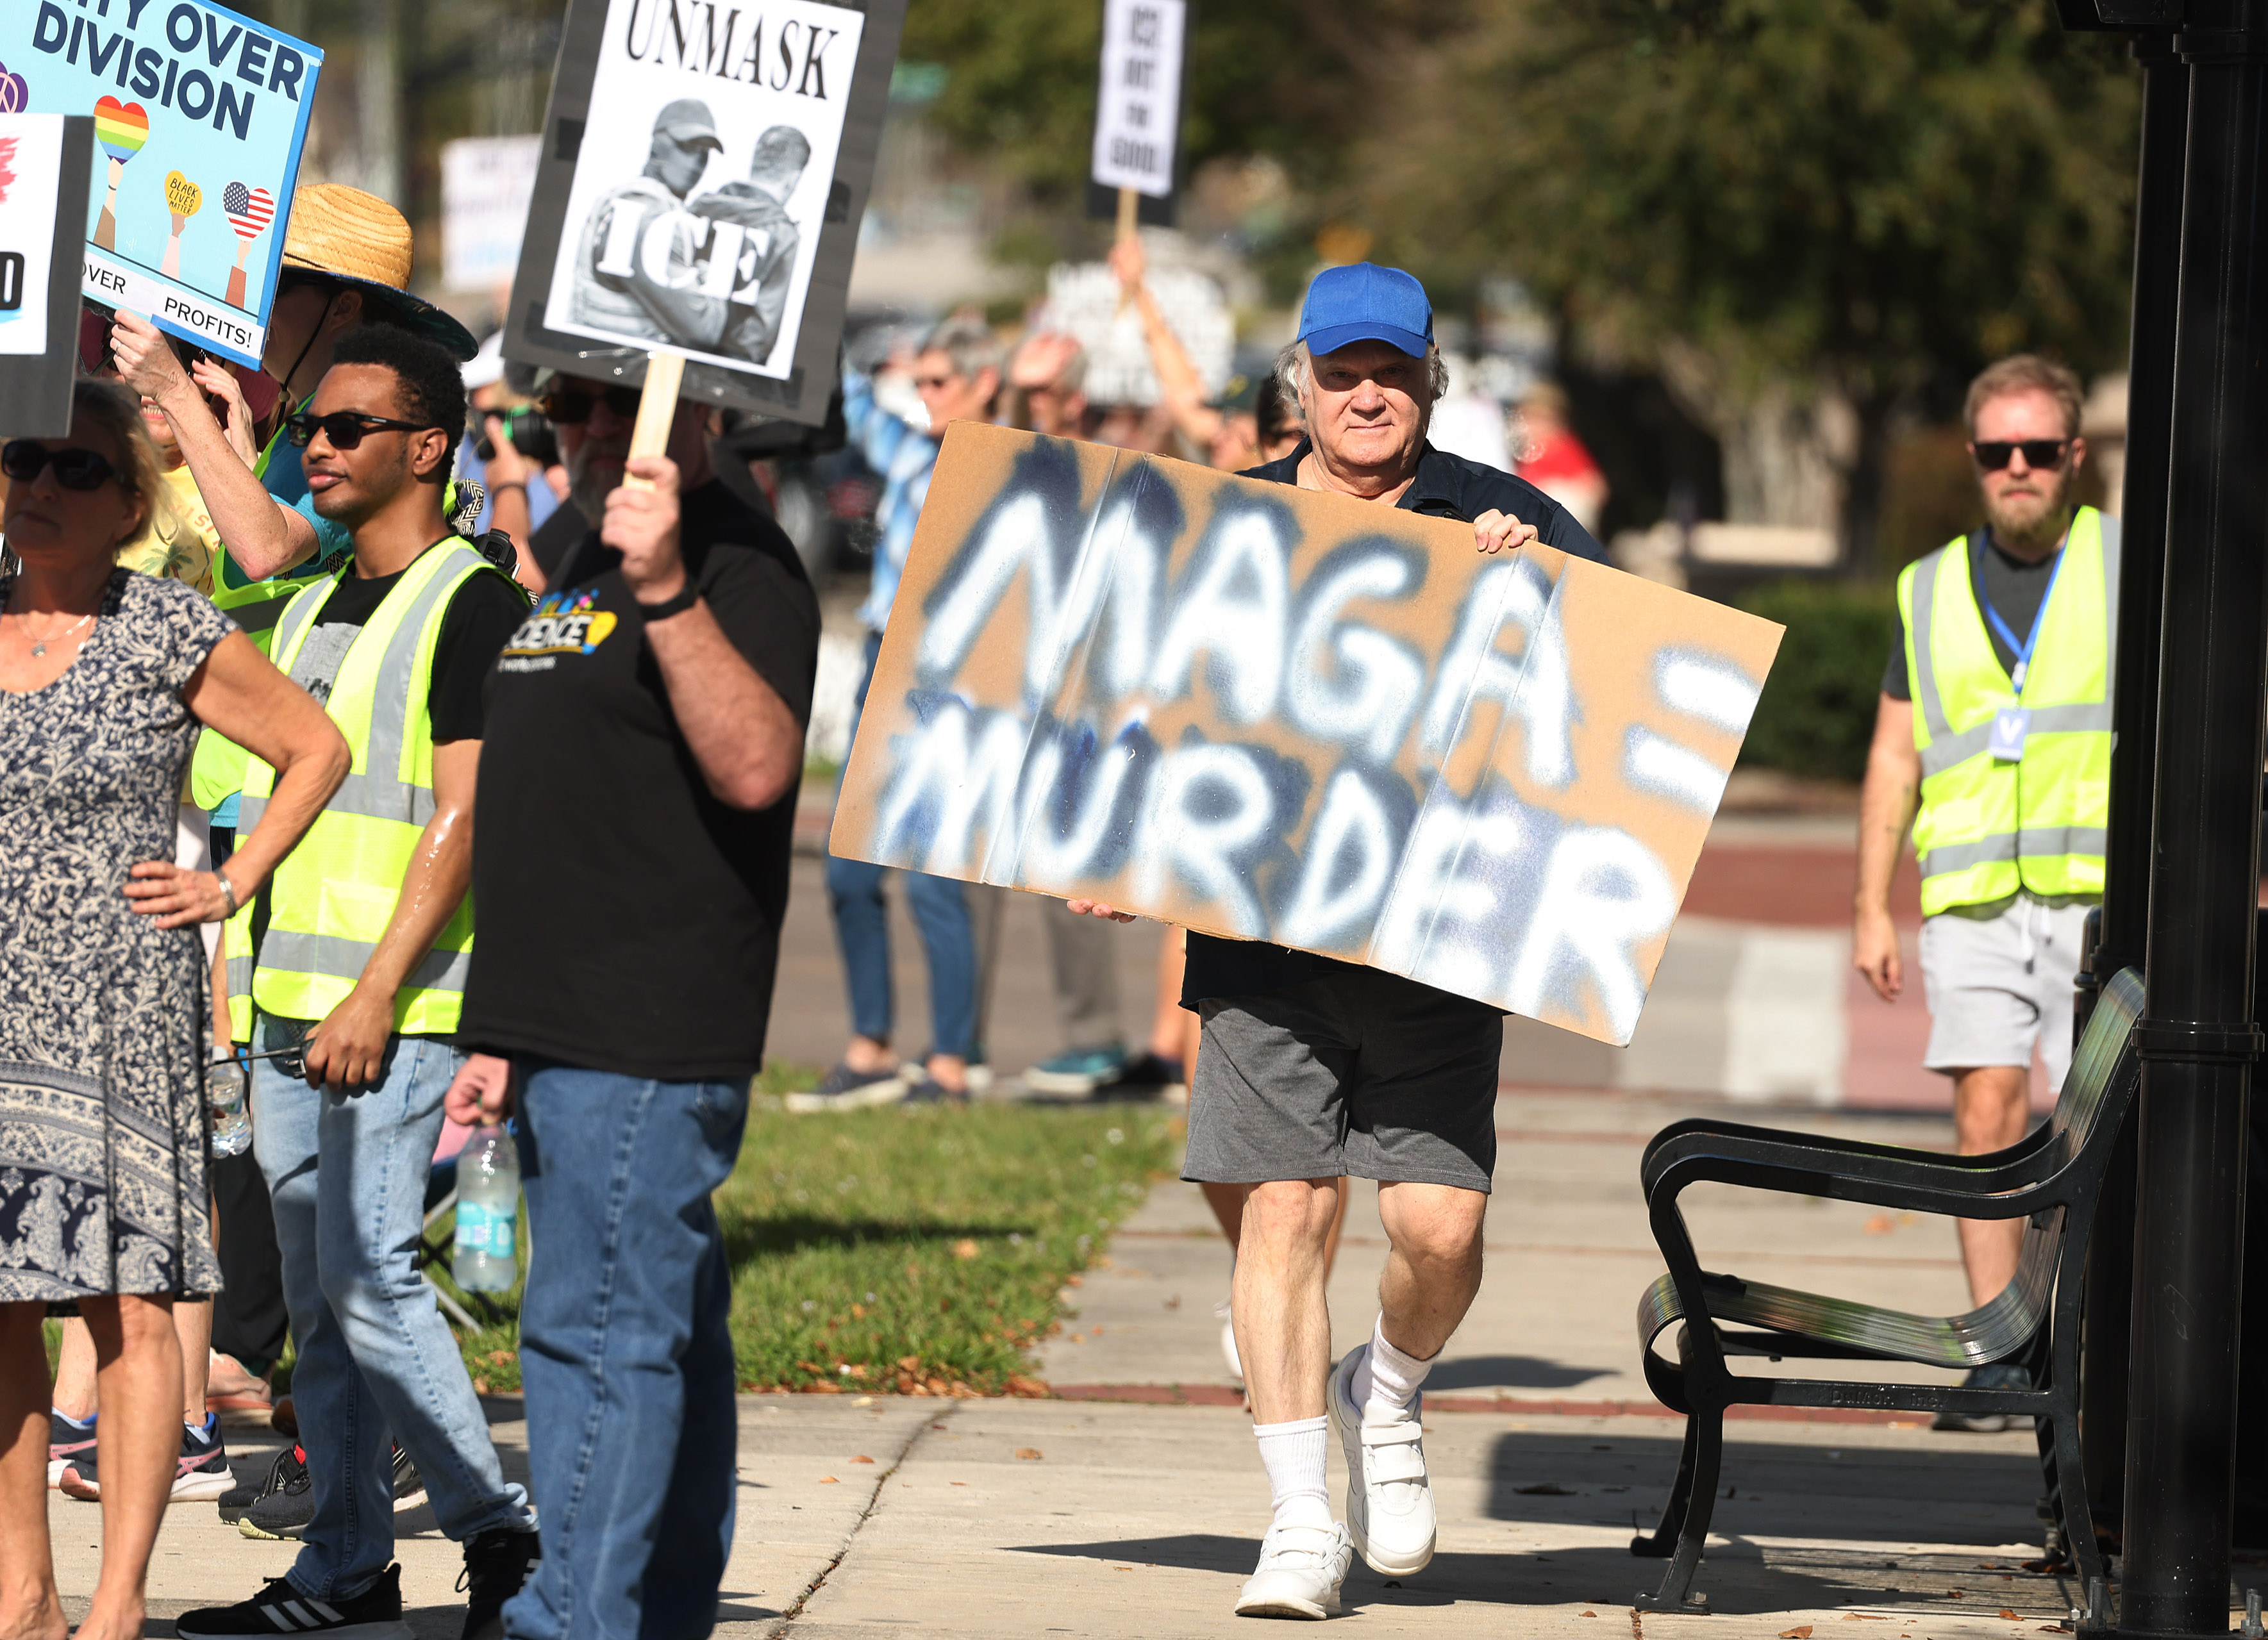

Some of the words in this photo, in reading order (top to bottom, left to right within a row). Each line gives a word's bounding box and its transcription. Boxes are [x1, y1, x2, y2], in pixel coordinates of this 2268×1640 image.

[33, 0, 255, 141] DIVISION
[167, 3, 304, 102] OVER
[627, 0, 839, 100] UNMASK
[169, 189, 194, 208] LIVES
[169, 200, 191, 215] MATTER
[170, 178, 198, 199] BLACK
[596, 197, 771, 306] ICE
[82, 261, 124, 295] VER
[164, 296, 252, 348] PROFITS!
[919, 442, 1580, 788] MAGA
[872, 693, 1676, 1043] MURDER
